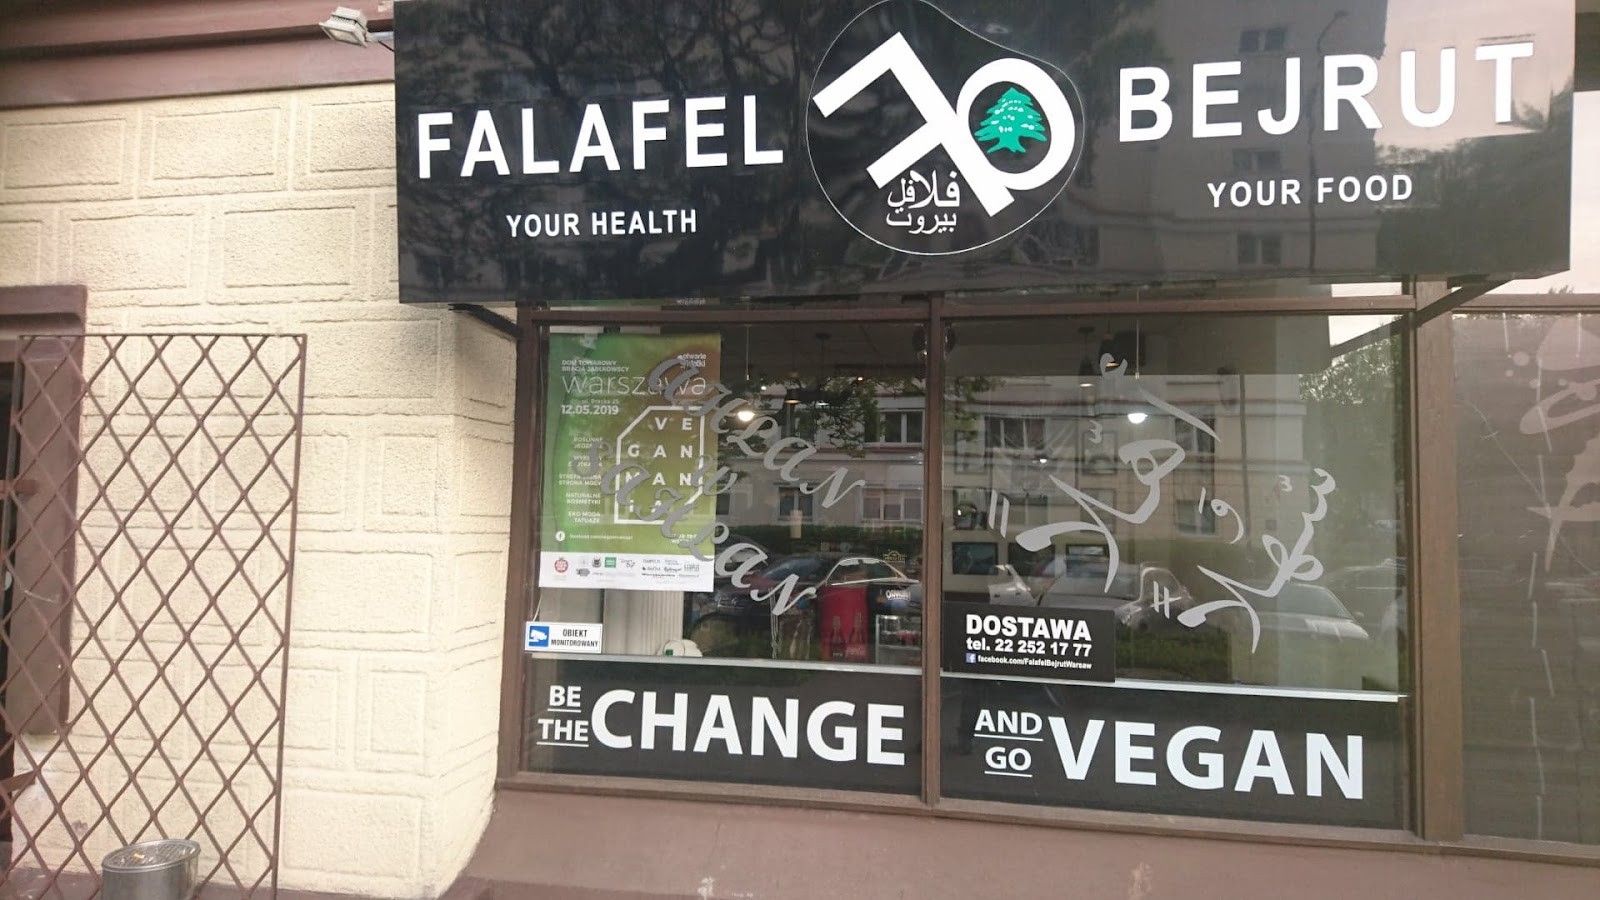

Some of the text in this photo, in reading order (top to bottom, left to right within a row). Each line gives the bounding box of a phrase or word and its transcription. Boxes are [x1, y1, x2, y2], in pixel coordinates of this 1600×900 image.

[1119, 42, 1534, 142] BEJRUT
[418, 95, 784, 179] FALAFEL
[1207, 175, 1413, 208] YOUR FOOD
[507, 209, 697, 237] YOUR HEALTH
[560, 404, 619, 416] 12.05.2019
[562, 628, 588, 638] OBIEKT
[966, 614, 1092, 641] DOSTAWA
[551, 639, 599, 647] MONITOROWANY
[966, 637, 1093, 657] tel. 22 252 17 77
[977, 654, 1092, 670] facebook.com/FalafelBejrutWarsaw
[549, 685, 582, 708] BE
[537, 718, 589, 742] THE
[591, 689, 905, 766] CHANGE
[974, 709, 1043, 736] AND
[984, 746, 1033, 772] GO
[1047, 716, 1363, 800] VEGAN
